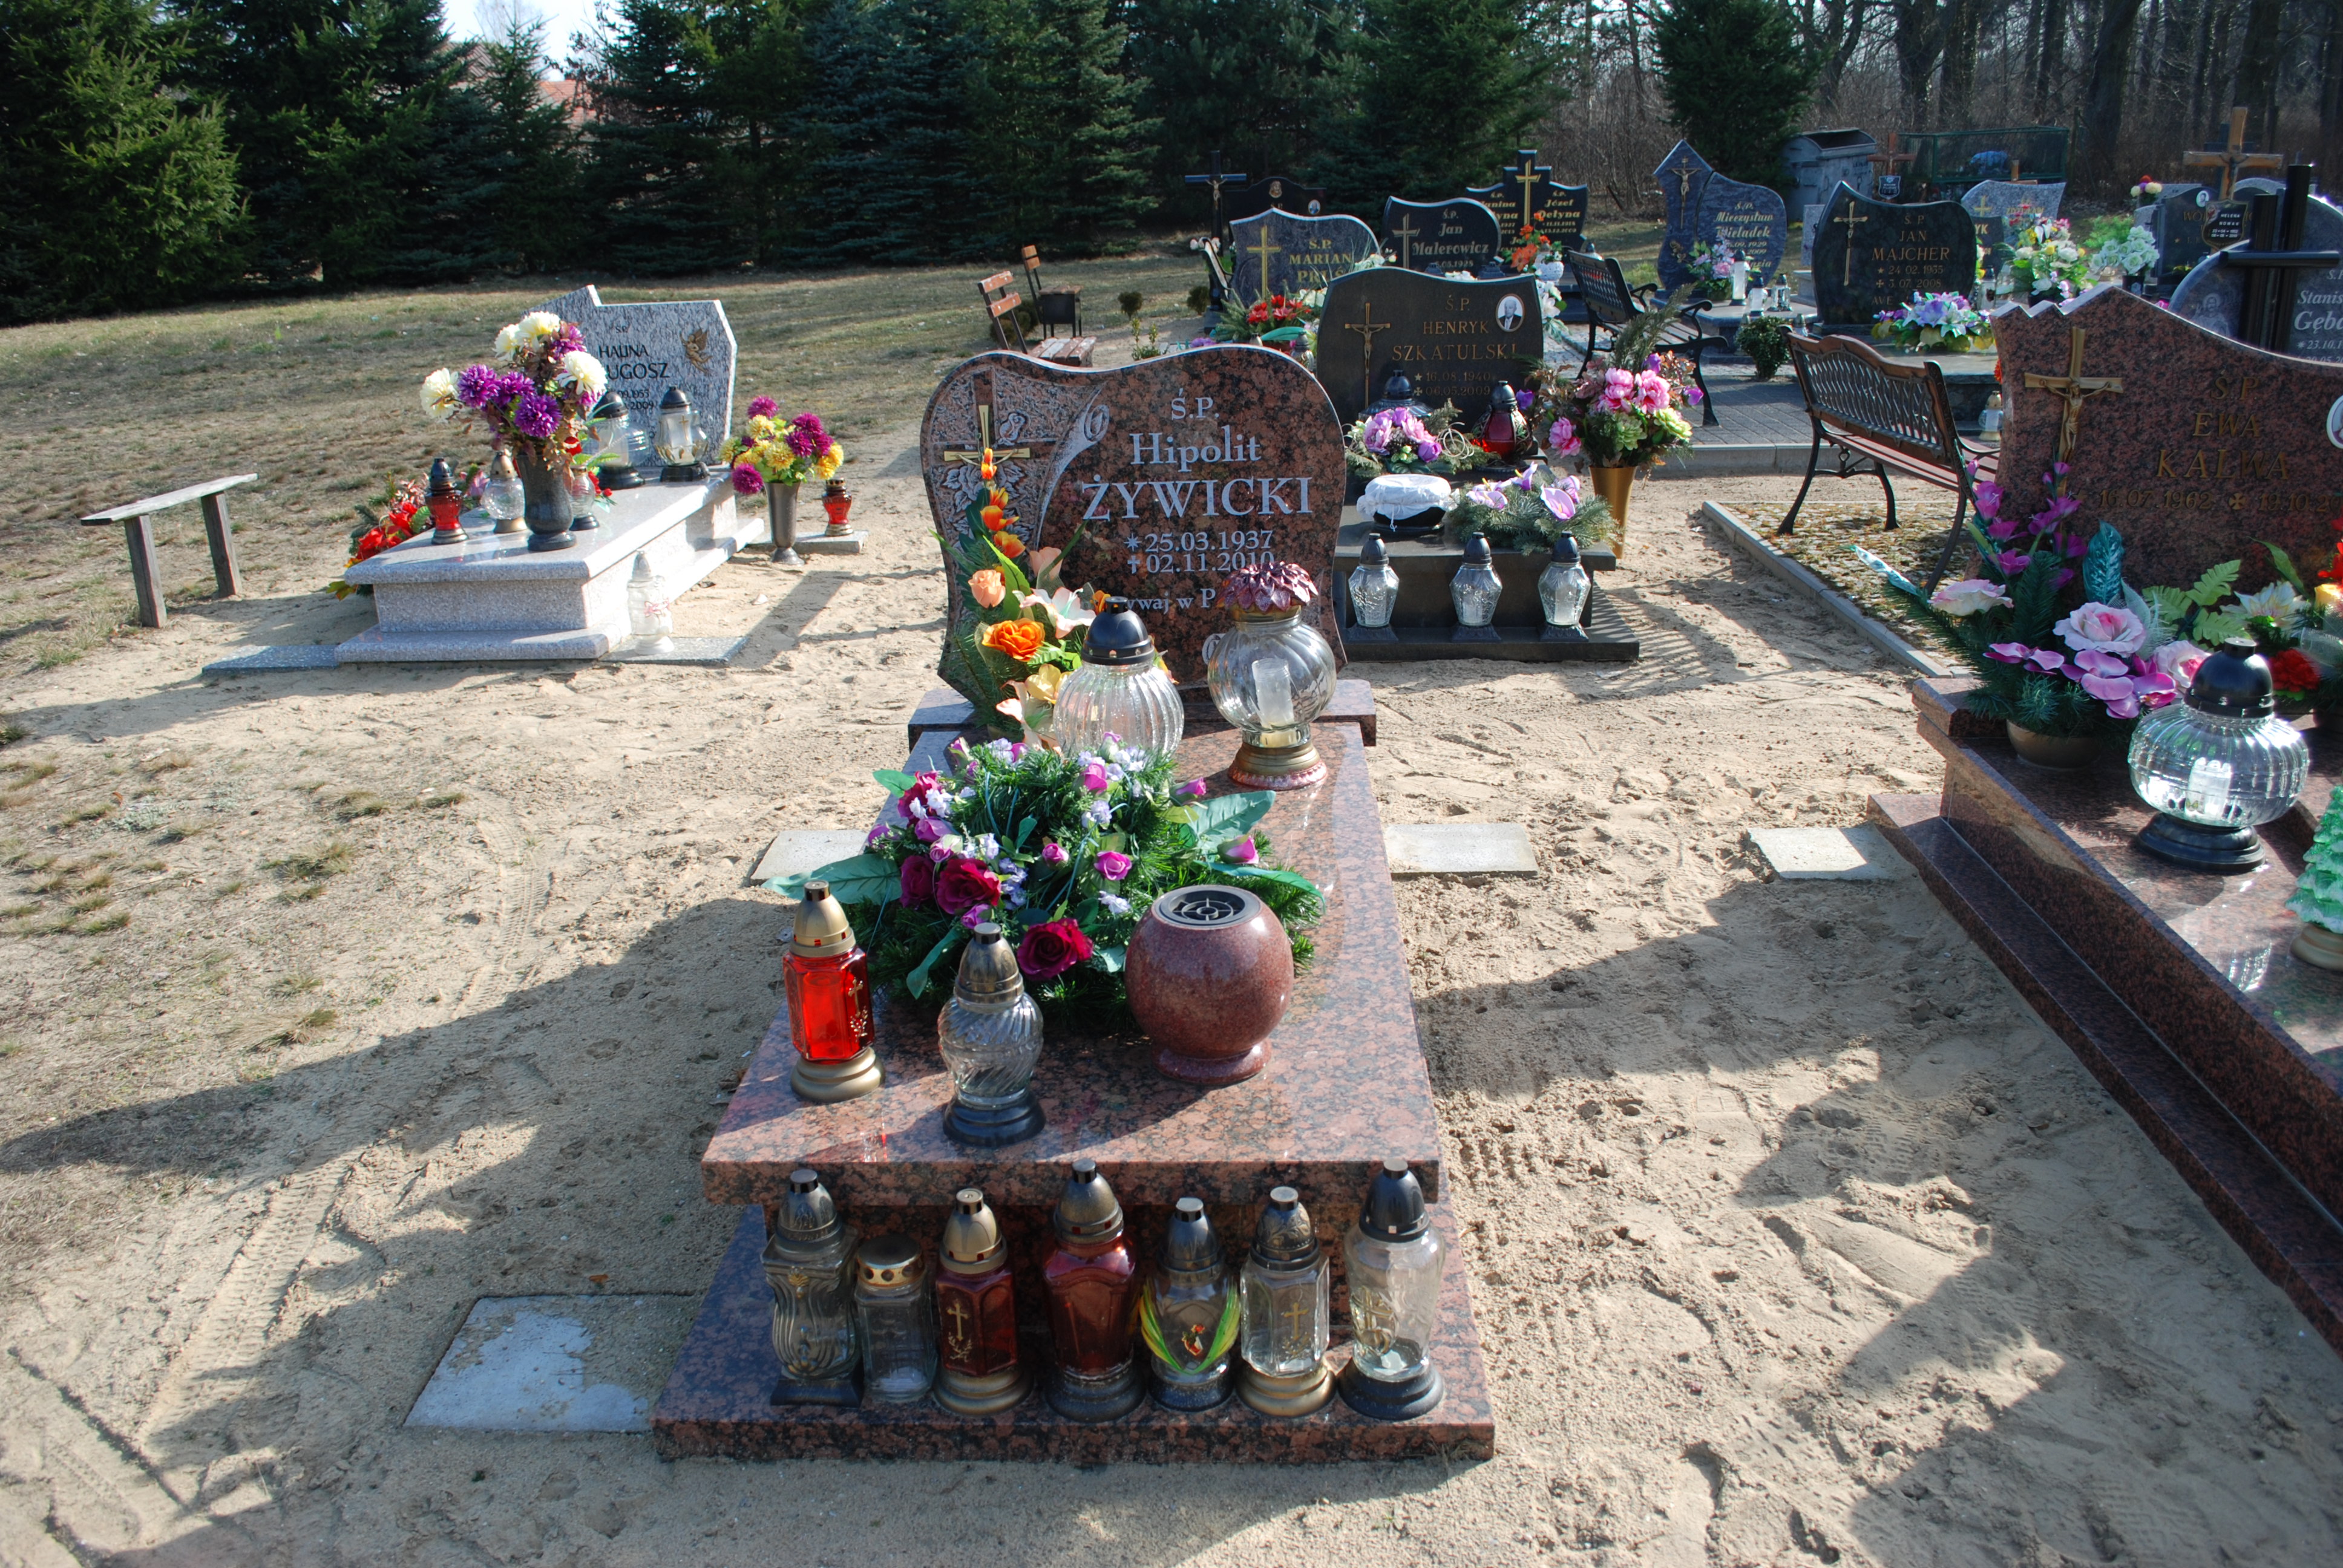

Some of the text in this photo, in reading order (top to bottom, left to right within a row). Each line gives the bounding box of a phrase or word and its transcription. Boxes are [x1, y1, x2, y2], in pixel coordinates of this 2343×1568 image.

[1714, 211, 1774, 223] Mieczysław
[1438, 223, 1463, 237] Jan
[1899, 231, 1927, 241] JAN
[1412, 241, 1489, 256] Malerowicz
[1872, 247, 1950, 261] MAJCHER
[1289, 253, 1351, 264] MARIAN
[1749, 258, 1772, 267] aria
[1423, 321, 1489, 335] HENRYK
[598, 344, 649, 359] HALINA
[606, 362, 670, 380] UGOSZ
[1425, 386, 1491, 397] 06.05.2009
[1170, 387, 1221, 420] Ś.P.
[2192, 413, 2261, 438] EWA
[1130, 425, 1262, 472] Hipolit
[2155, 448, 2289, 480] KALWA
[1081, 474, 1313, 521] ŻYWICKI
[2099, 488, 2214, 509] 16.07.1962
[1144, 528, 1274, 553] 25.03.1937
[1127, 590, 1169, 615] ywaj
[1176, 597, 1194, 609] w
